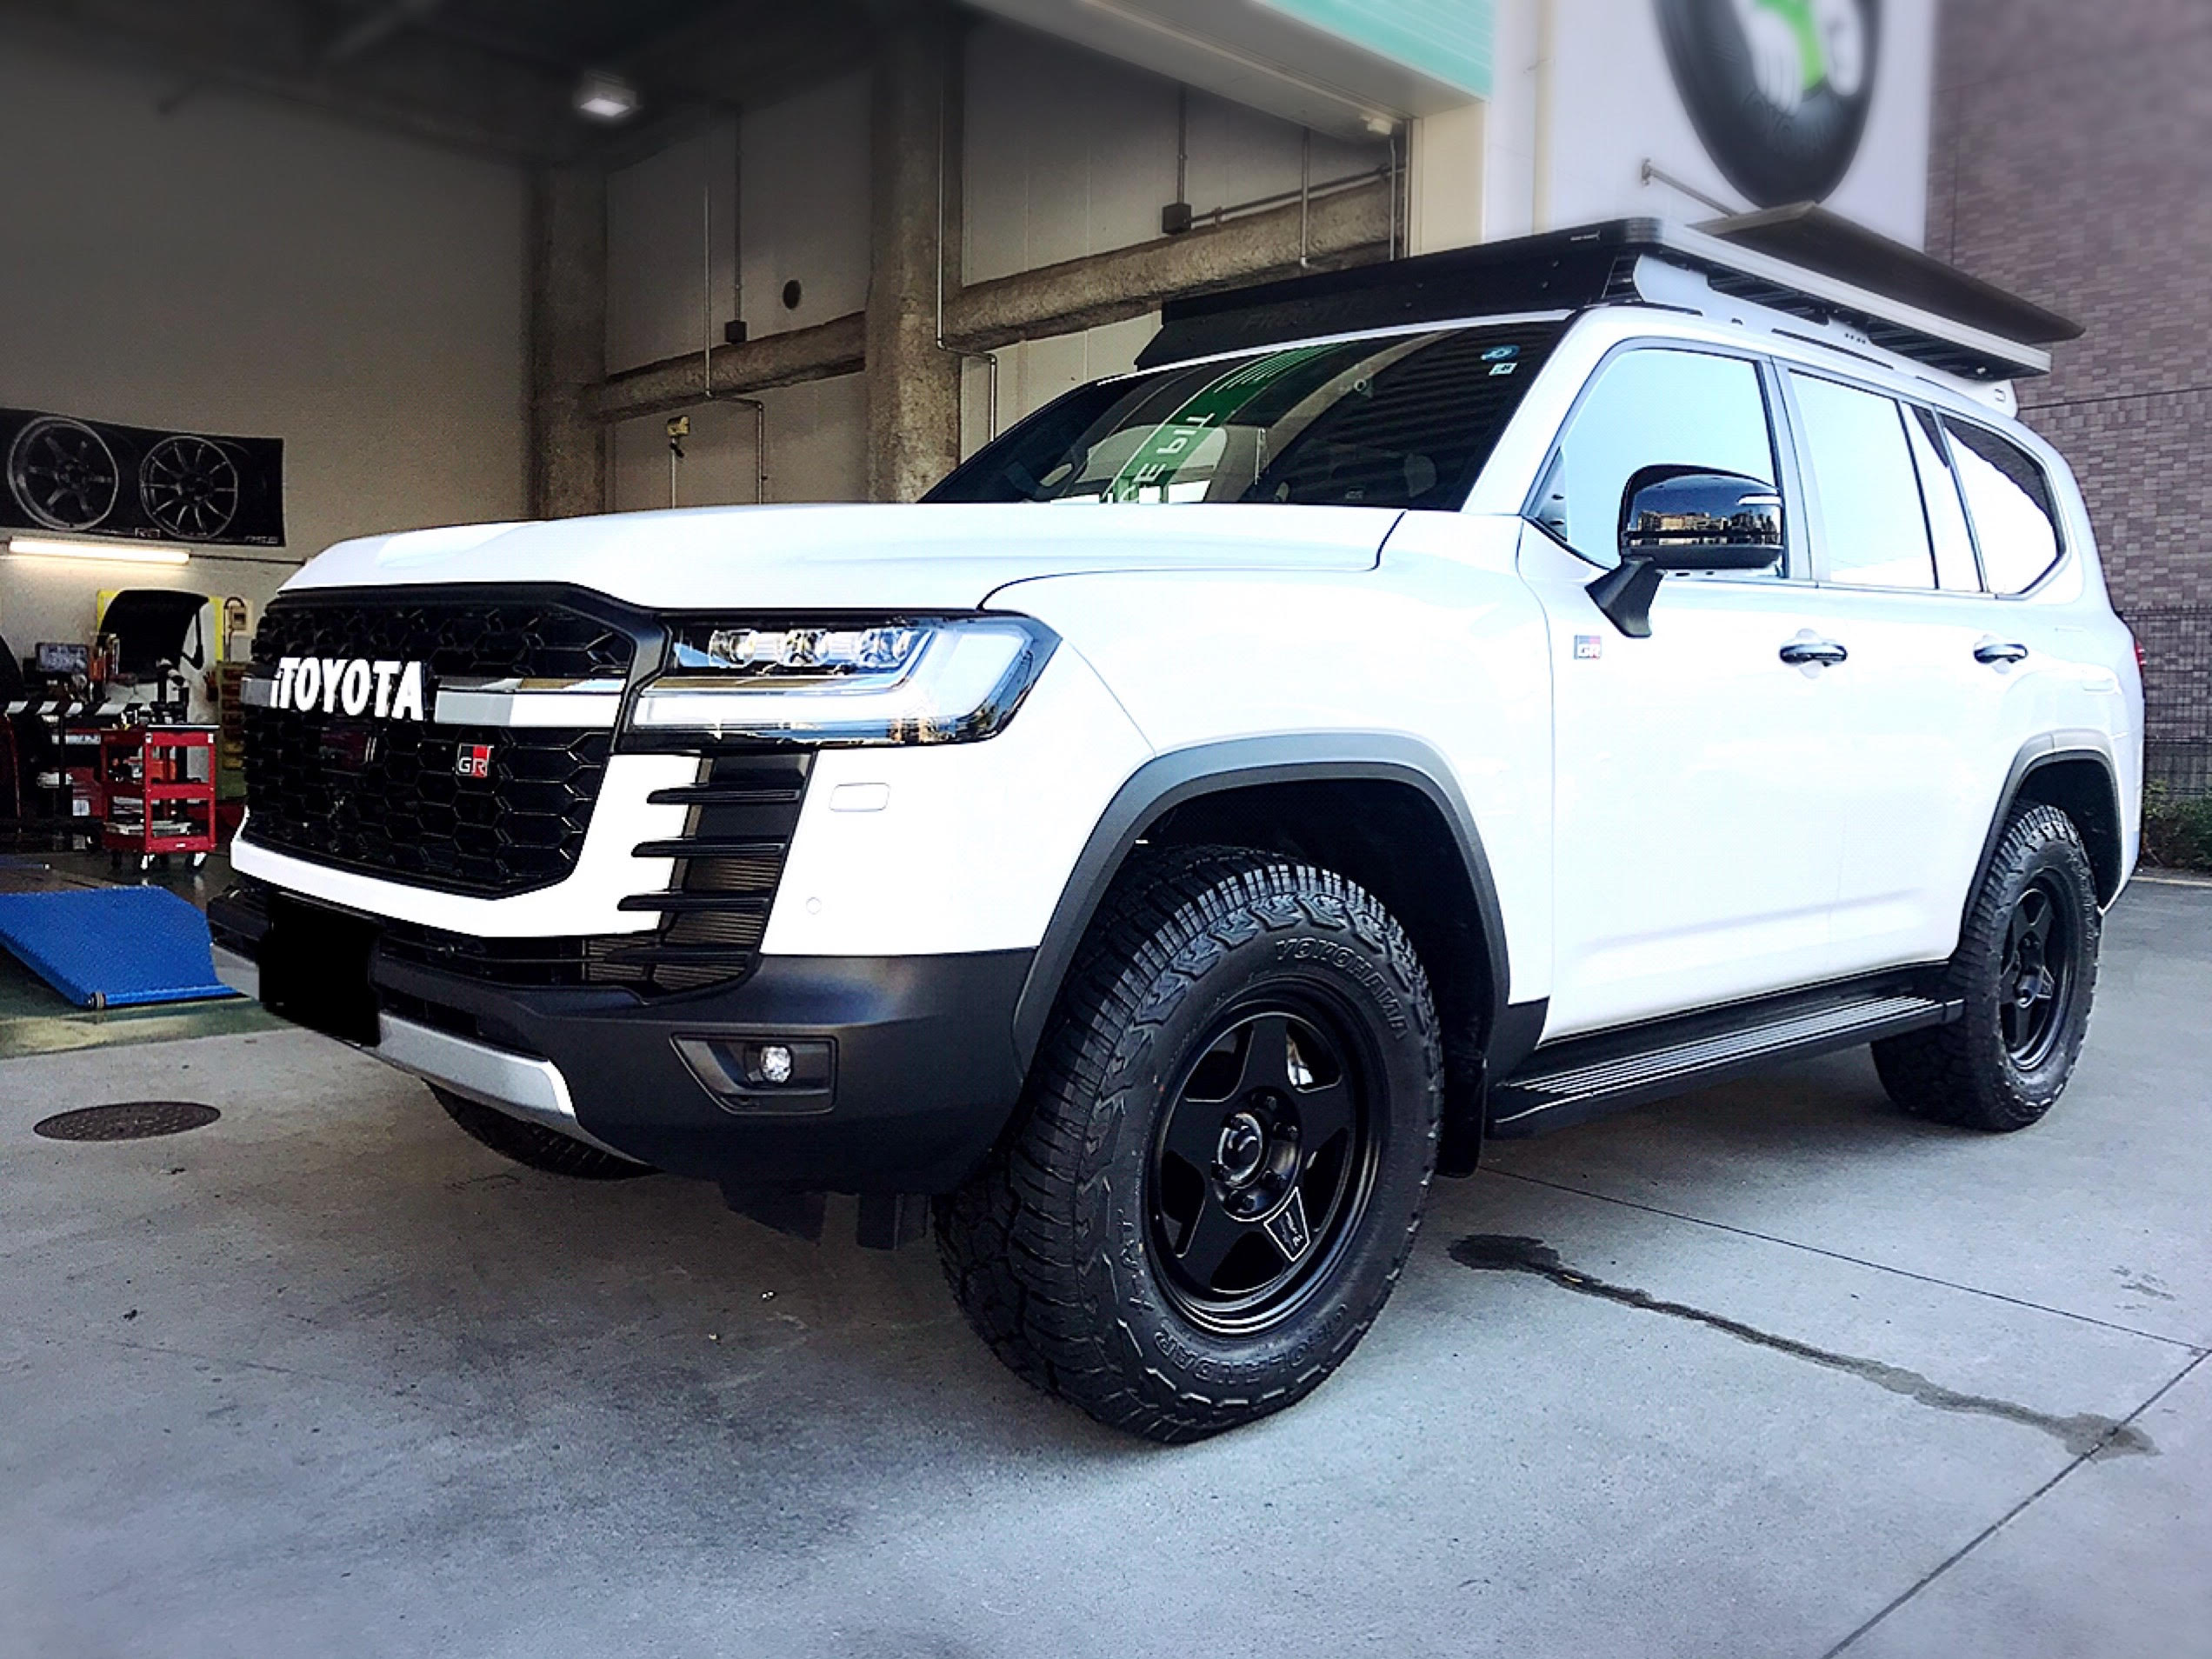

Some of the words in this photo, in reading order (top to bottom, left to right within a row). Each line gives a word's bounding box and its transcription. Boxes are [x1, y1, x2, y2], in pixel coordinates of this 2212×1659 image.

[277, 656, 423, 721] TOYOTA
[458, 756, 488, 776] GR
[1275, 936, 1408, 1041] YOKOHAMA
